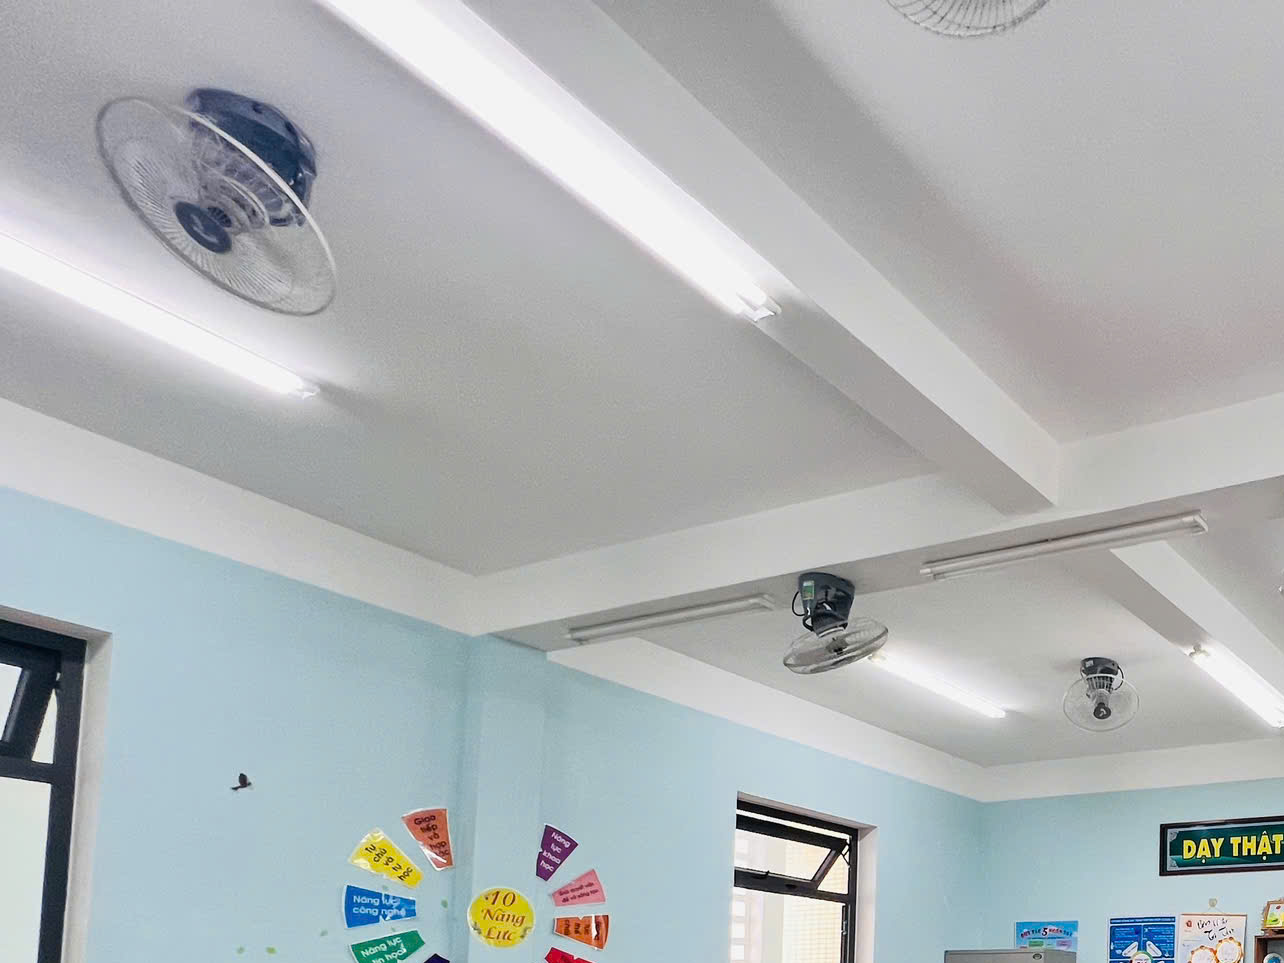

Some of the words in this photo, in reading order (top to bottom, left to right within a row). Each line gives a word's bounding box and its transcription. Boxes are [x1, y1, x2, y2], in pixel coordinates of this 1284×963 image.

[413, 815, 436, 825] Giao
[1183, 837, 1224, 864] DẠY
[1230, 830, 1284, 861] THẬT
[353, 895, 380, 906] Năng
[486, 890, 516, 907] 10
[352, 906, 379, 917] công
[481, 908, 526, 928] Năng
[1041, 927, 1048, 936] 5
